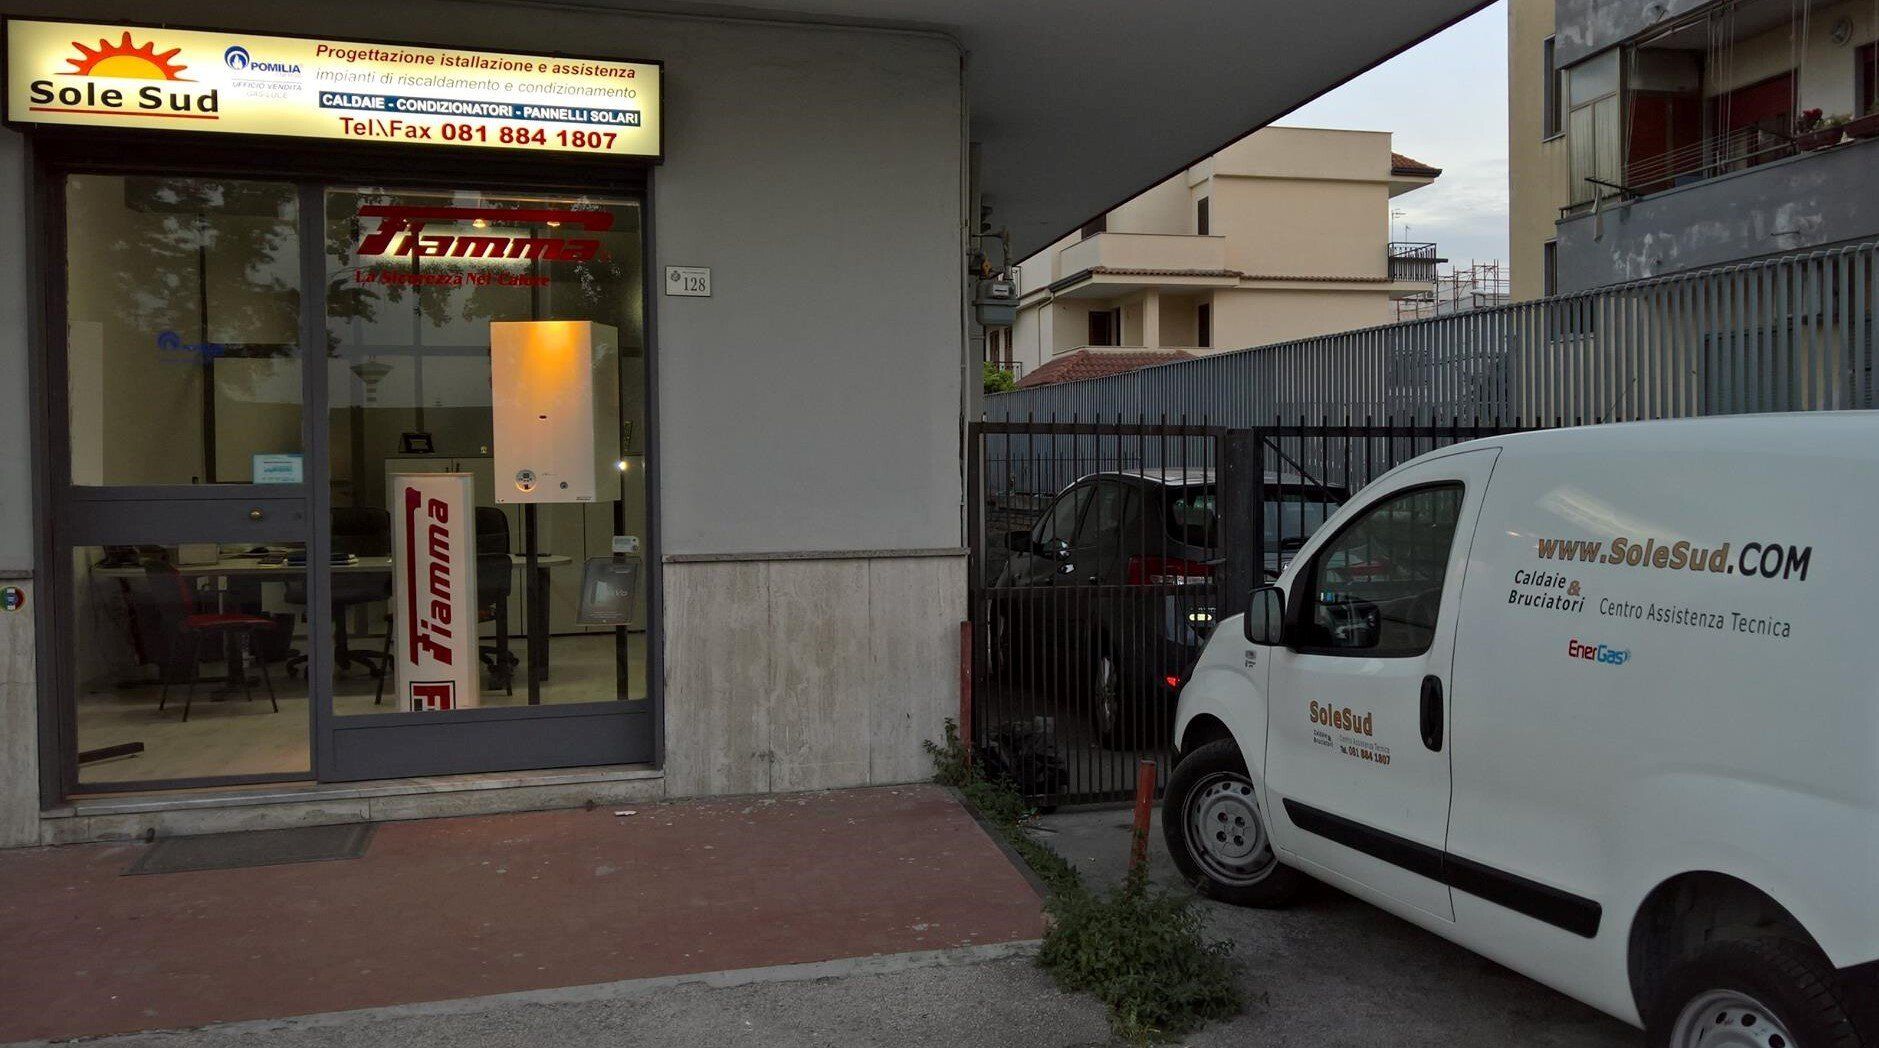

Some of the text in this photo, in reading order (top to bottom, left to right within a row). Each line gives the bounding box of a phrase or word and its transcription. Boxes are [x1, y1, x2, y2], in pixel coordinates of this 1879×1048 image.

[250, 62, 301, 74] POMILIA
[315, 44, 636, 79] Progettazione istallazione e assistenza
[29, 80, 219, 113] Sole Sud
[315, 68, 376, 85] impianti
[380, 72, 394, 85] di
[397, 73, 500, 92] riscaldamento
[504, 82, 513, 92] e
[518, 82, 637, 99] condizionamento
[322, 93, 385, 109] CALDAIE
[396, 98, 513, 117] CONDIZIONATORI
[523, 106, 587, 121] PANNELLI
[590, 110, 639, 125] SOLARI
[441, 123, 489, 143] 081
[499, 127, 547, 146] 884
[556, 130, 618, 150] 1807
[357, 205, 614, 262] Fiamma
[683, 277, 706, 291] 128
[1537, 537, 1813, 582] www.SoleSud.COM
[405, 486, 453, 666] Fiamma
[1513, 569, 1581, 597] Caldaie &
[1508, 589, 1586, 613] Bruciatori
[1599, 597, 1792, 639] Centro Assistenza Tecnica
[1568, 639, 1625, 666] EnerGas
[1309, 700, 1373, 736] SoleSud
[1348, 746, 1359, 758] 081
[1360, 749, 1373, 761] 884
[1374, 752, 1391, 765] 1807
